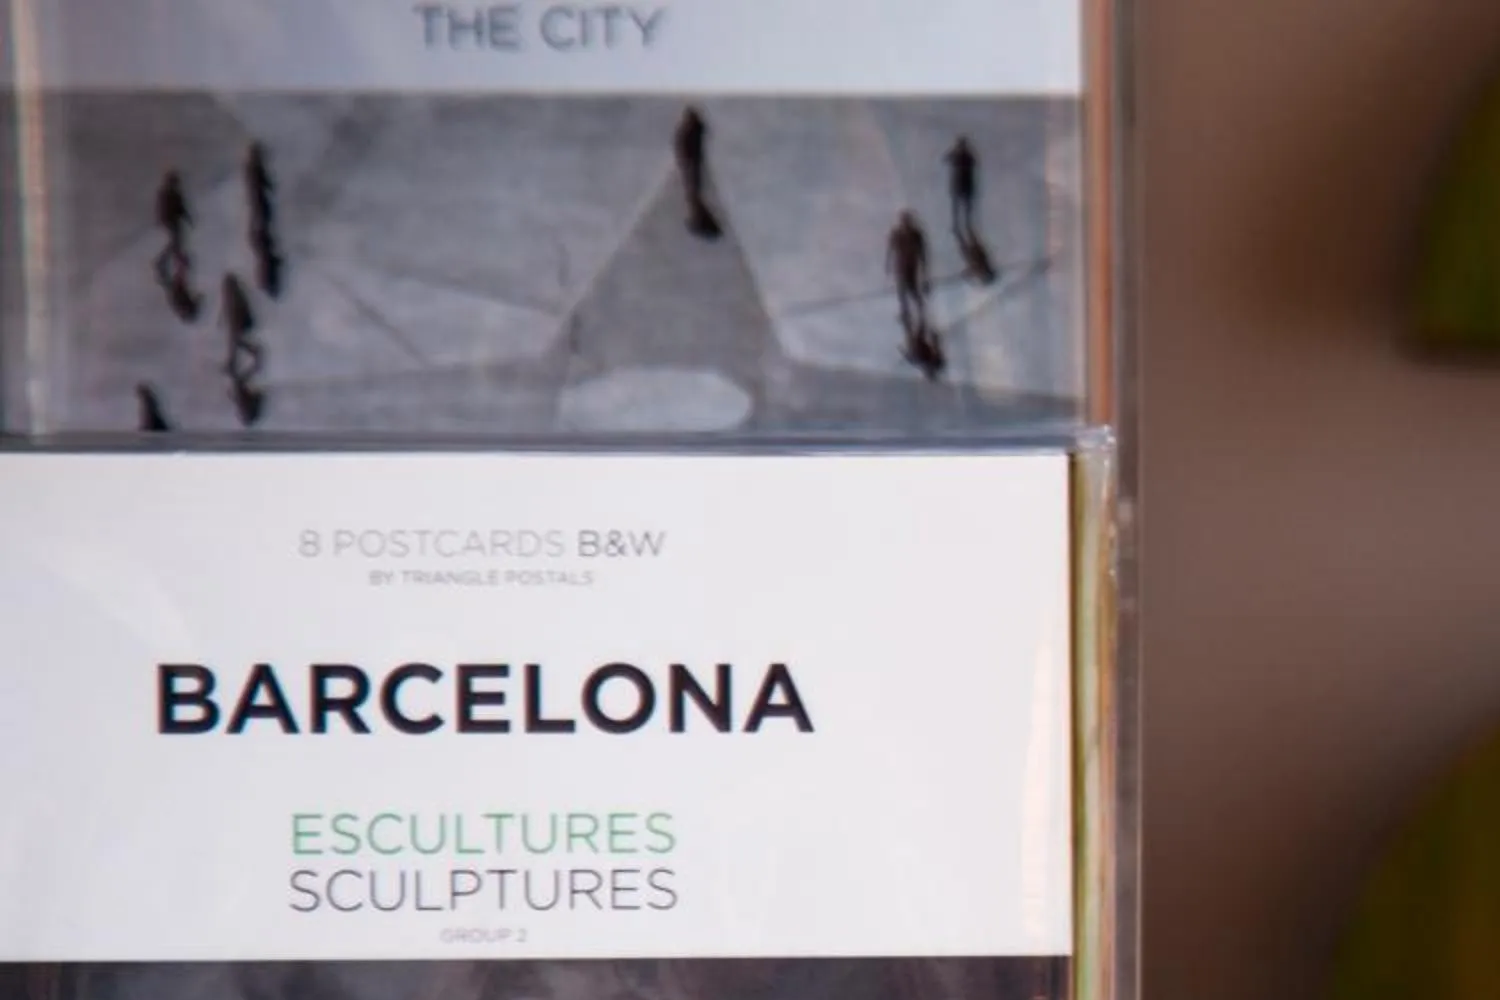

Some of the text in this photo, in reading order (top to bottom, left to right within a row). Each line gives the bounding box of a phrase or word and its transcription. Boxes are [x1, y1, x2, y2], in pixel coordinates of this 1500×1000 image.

[412, 5, 666, 50] THE CITY
[298, 528, 666, 558] 8 POSTCARDS B&W
[368, 570, 595, 586] BY TRIANGLE POSTALS
[156, 662, 815, 735] BARCELONA
[291, 811, 677, 856] ESCULTURES
[288, 867, 679, 913] SCULPTURES
[439, 927, 512, 944] GROUP
